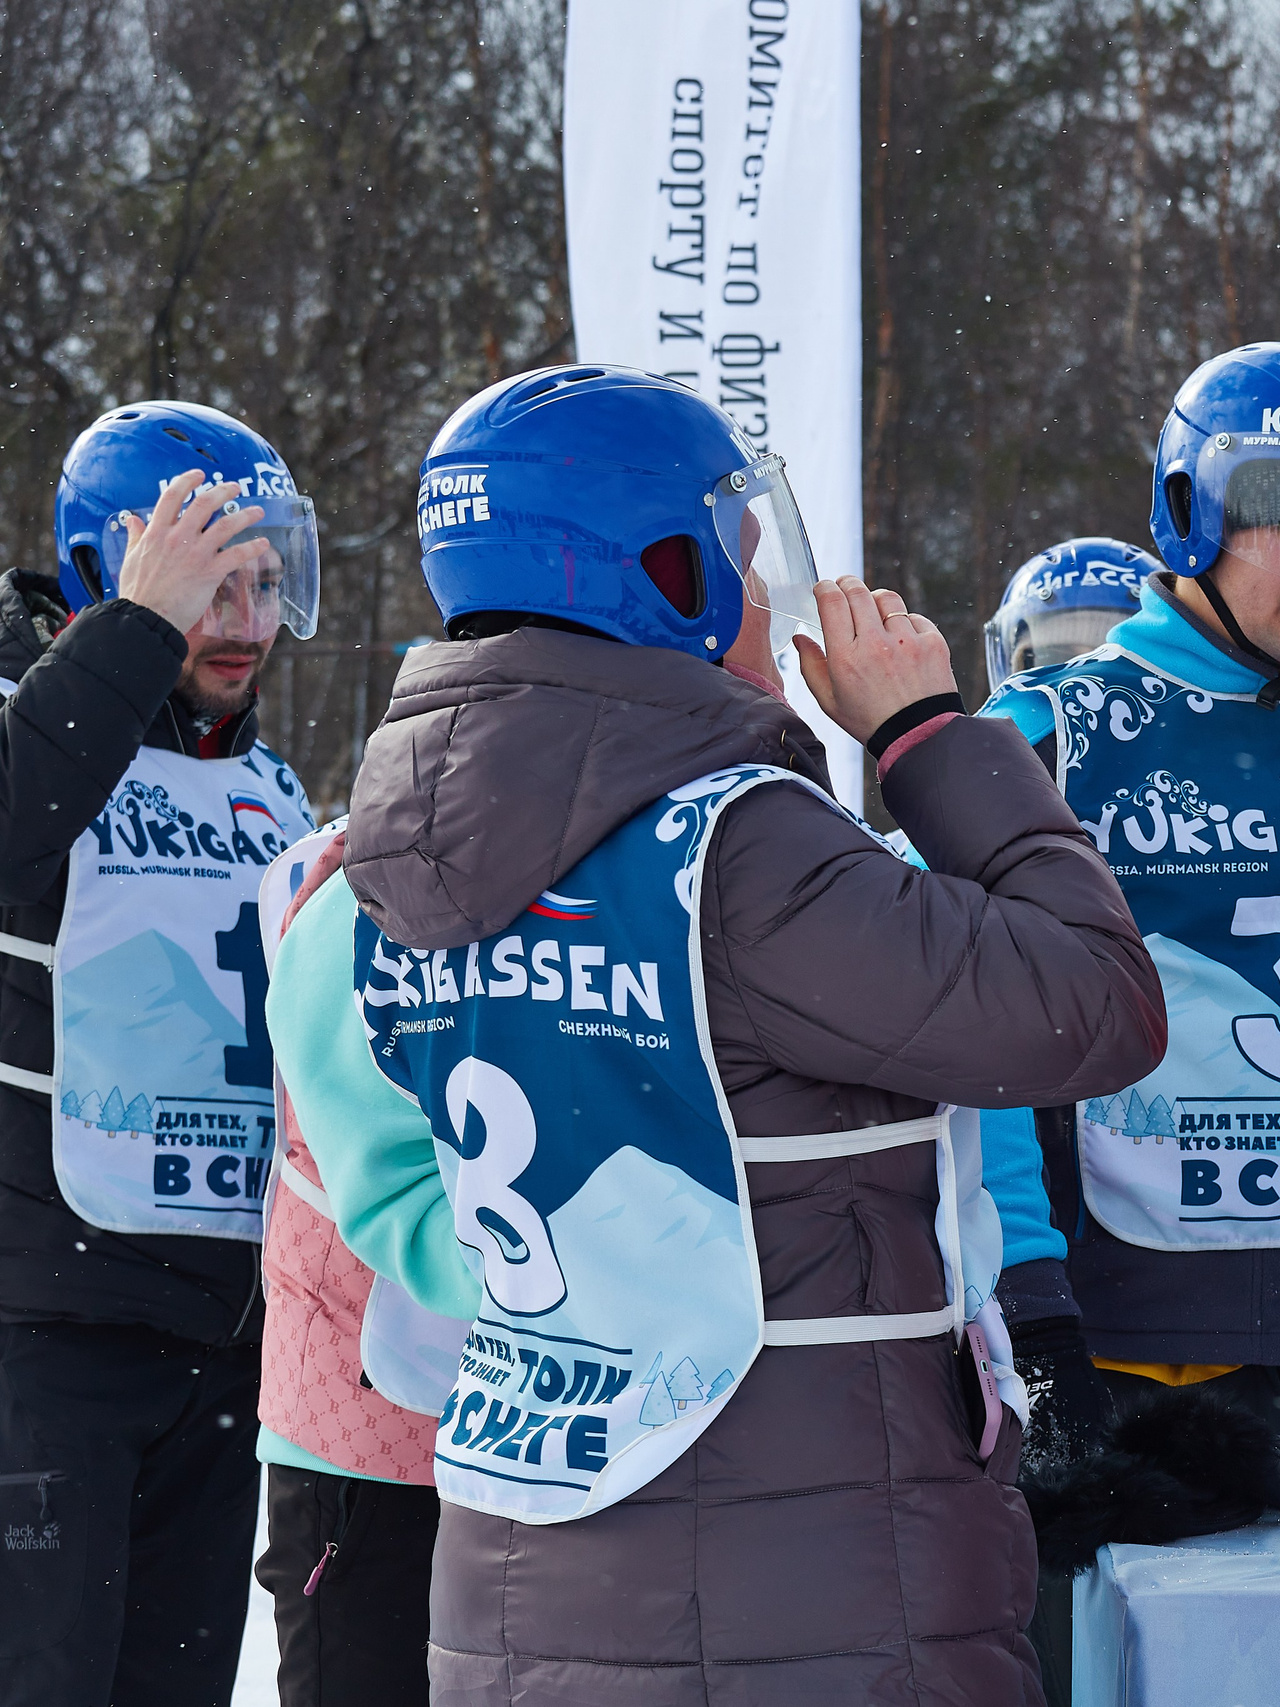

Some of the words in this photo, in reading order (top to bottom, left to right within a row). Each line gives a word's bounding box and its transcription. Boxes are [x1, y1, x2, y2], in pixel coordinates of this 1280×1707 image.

[653, 77, 706, 286] спорту
[431, 474, 487, 498] ТОЛК
[99, 864, 140, 876] RUSSIA,
[141, 865, 191, 878] MURMANSK
[194, 869, 231, 880] REGION
[1146, 863, 1220, 875] MURMANSK
[1223, 861, 1269, 873] REGION
[635, 1032, 670, 1050] БОЙ
[156, 1111, 202, 1130] ДЛЯ
[205, 1113, 247, 1132] ТЕХ,
[1179, 1113, 1232, 1133] ДЛЯ
[155, 1133, 193, 1147] КТО
[196, 1134, 248, 1149] ЗНАЕТ
[1179, 1136, 1221, 1151] КТО
[154, 1153, 192, 1197] В
[1180, 1159, 1223, 1207] В
[445, 1055, 568, 1318] 8
[4, 1524, 35, 1537] Jack
[5, 1536, 60, 1551] Wolfskin
